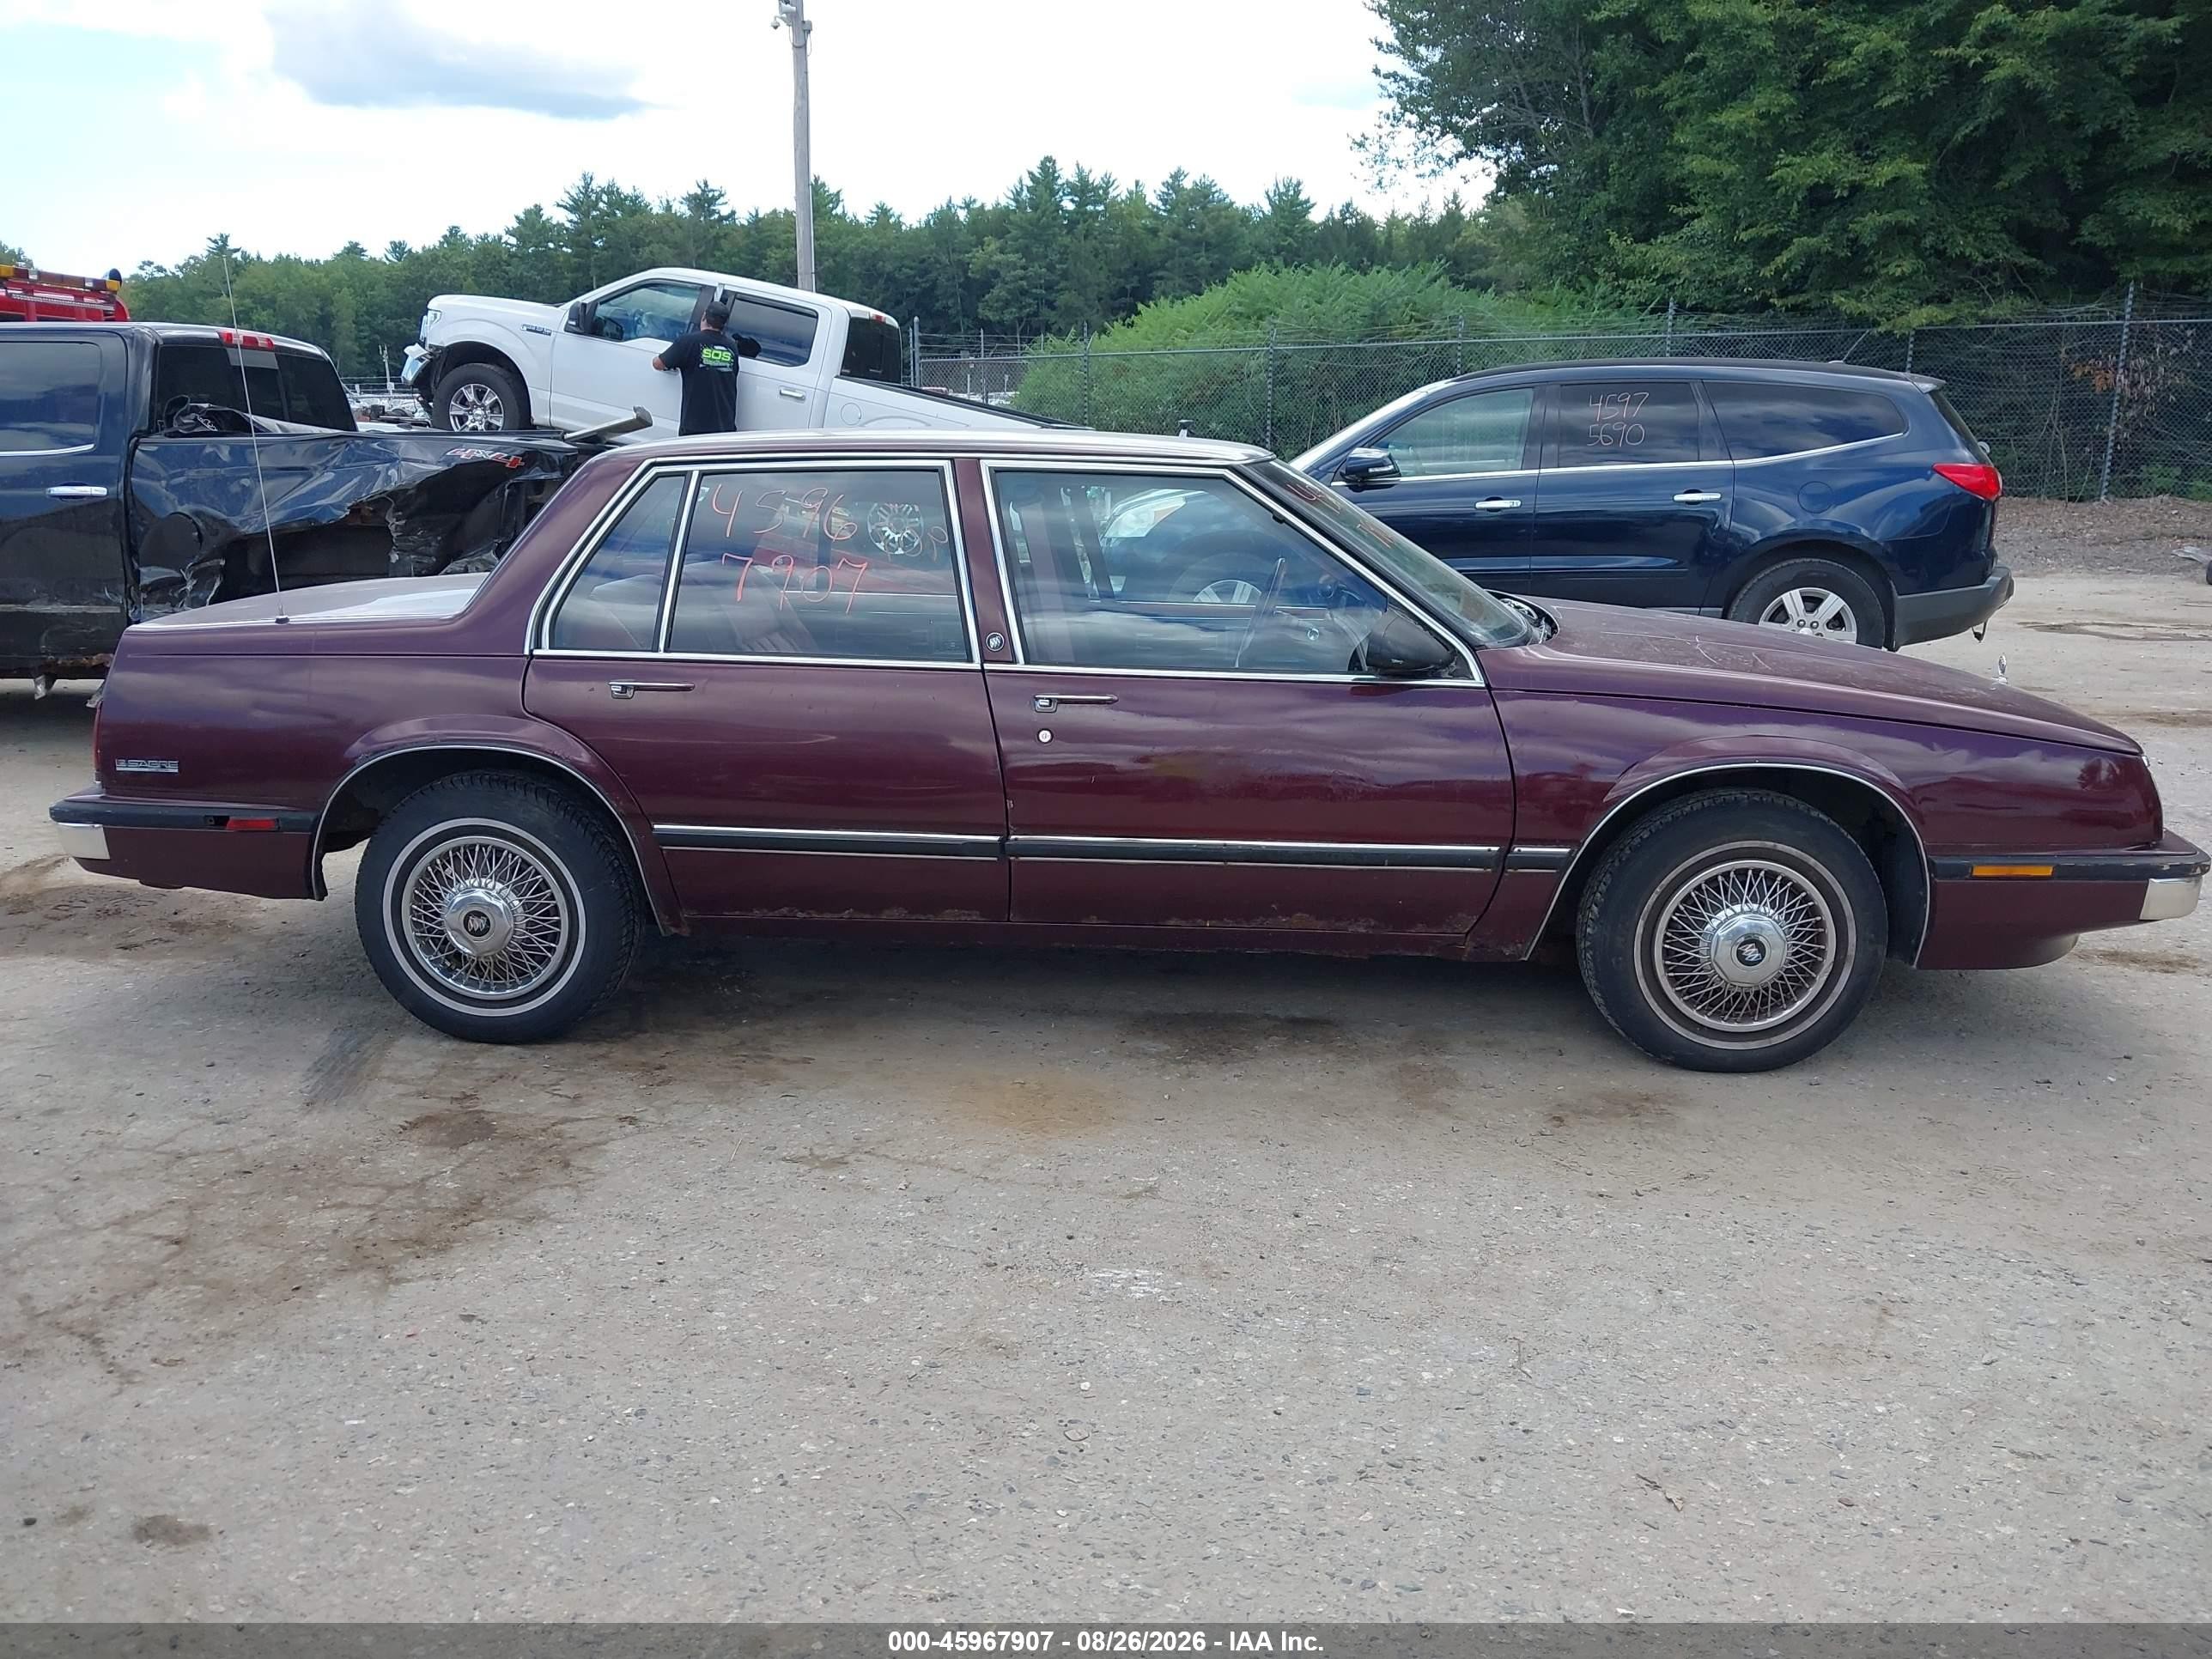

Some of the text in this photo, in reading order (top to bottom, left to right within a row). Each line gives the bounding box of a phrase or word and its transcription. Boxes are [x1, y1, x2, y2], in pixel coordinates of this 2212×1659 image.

[702, 348, 732, 362] SOS
[1589, 392, 1650, 422] 4597
[1587, 421, 1645, 447] 5690
[721, 552, 868, 614] 7907
